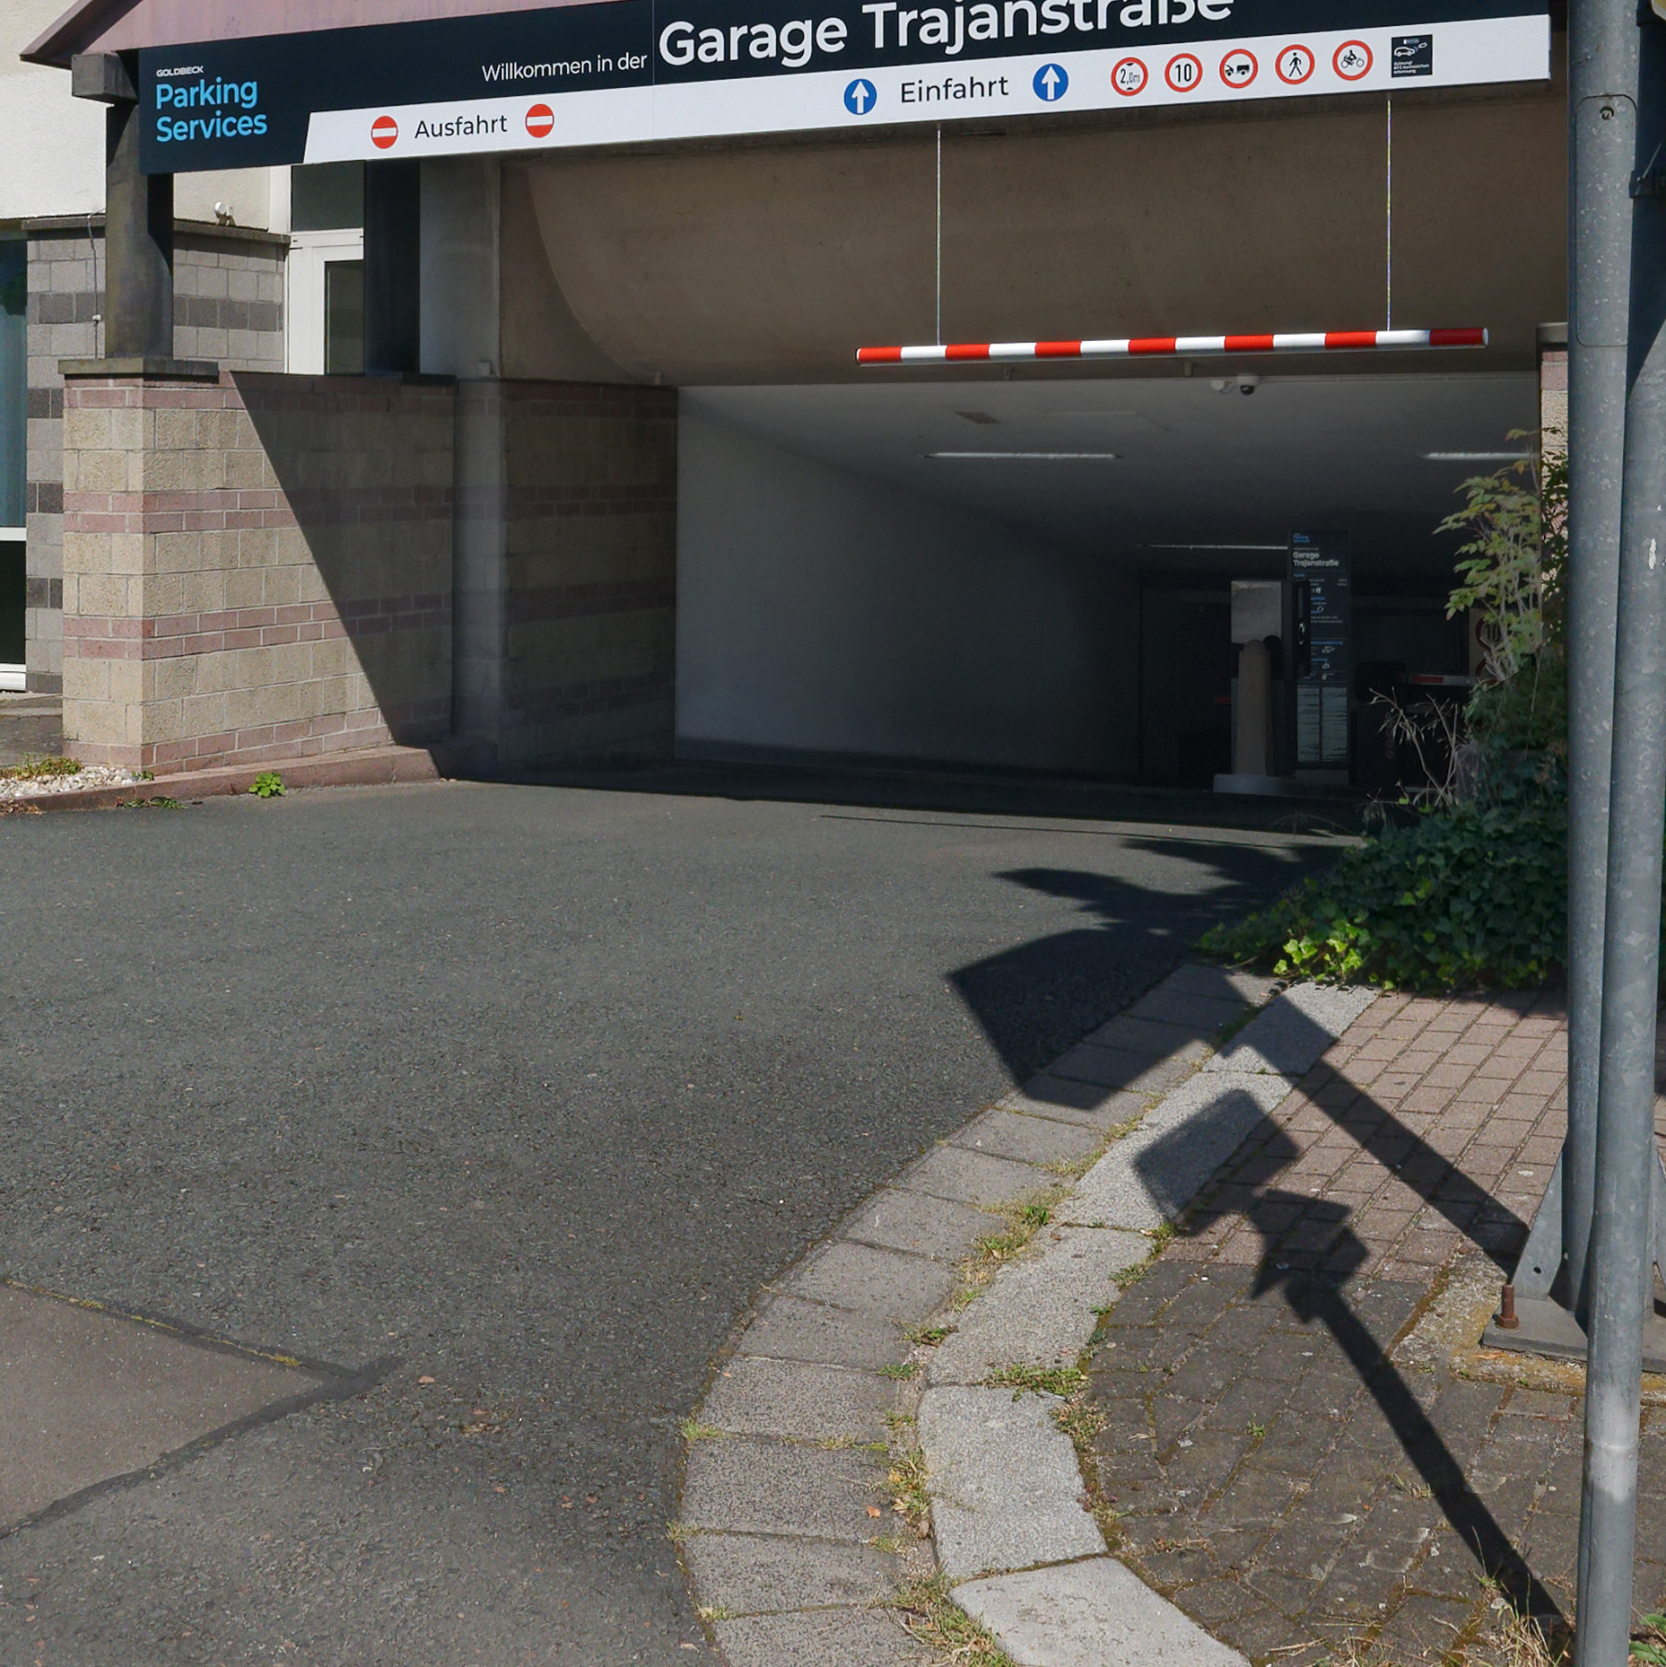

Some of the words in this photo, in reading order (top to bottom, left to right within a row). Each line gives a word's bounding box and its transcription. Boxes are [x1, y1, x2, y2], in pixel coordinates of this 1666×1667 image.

[482, 58, 592, 82] Willkommen
[596, 54, 613, 72] in
[617, 51, 648, 71] der
[659, 17, 848, 68] Garage
[156, 65, 204, 77] GOLDBECK
[1175, 63, 1192, 82] 10
[156, 76, 258, 110] Parking
[900, 75, 1010, 104] Einfahrt
[156, 109, 268, 143] Services
[414, 114, 508, 139] Ausfahrt
